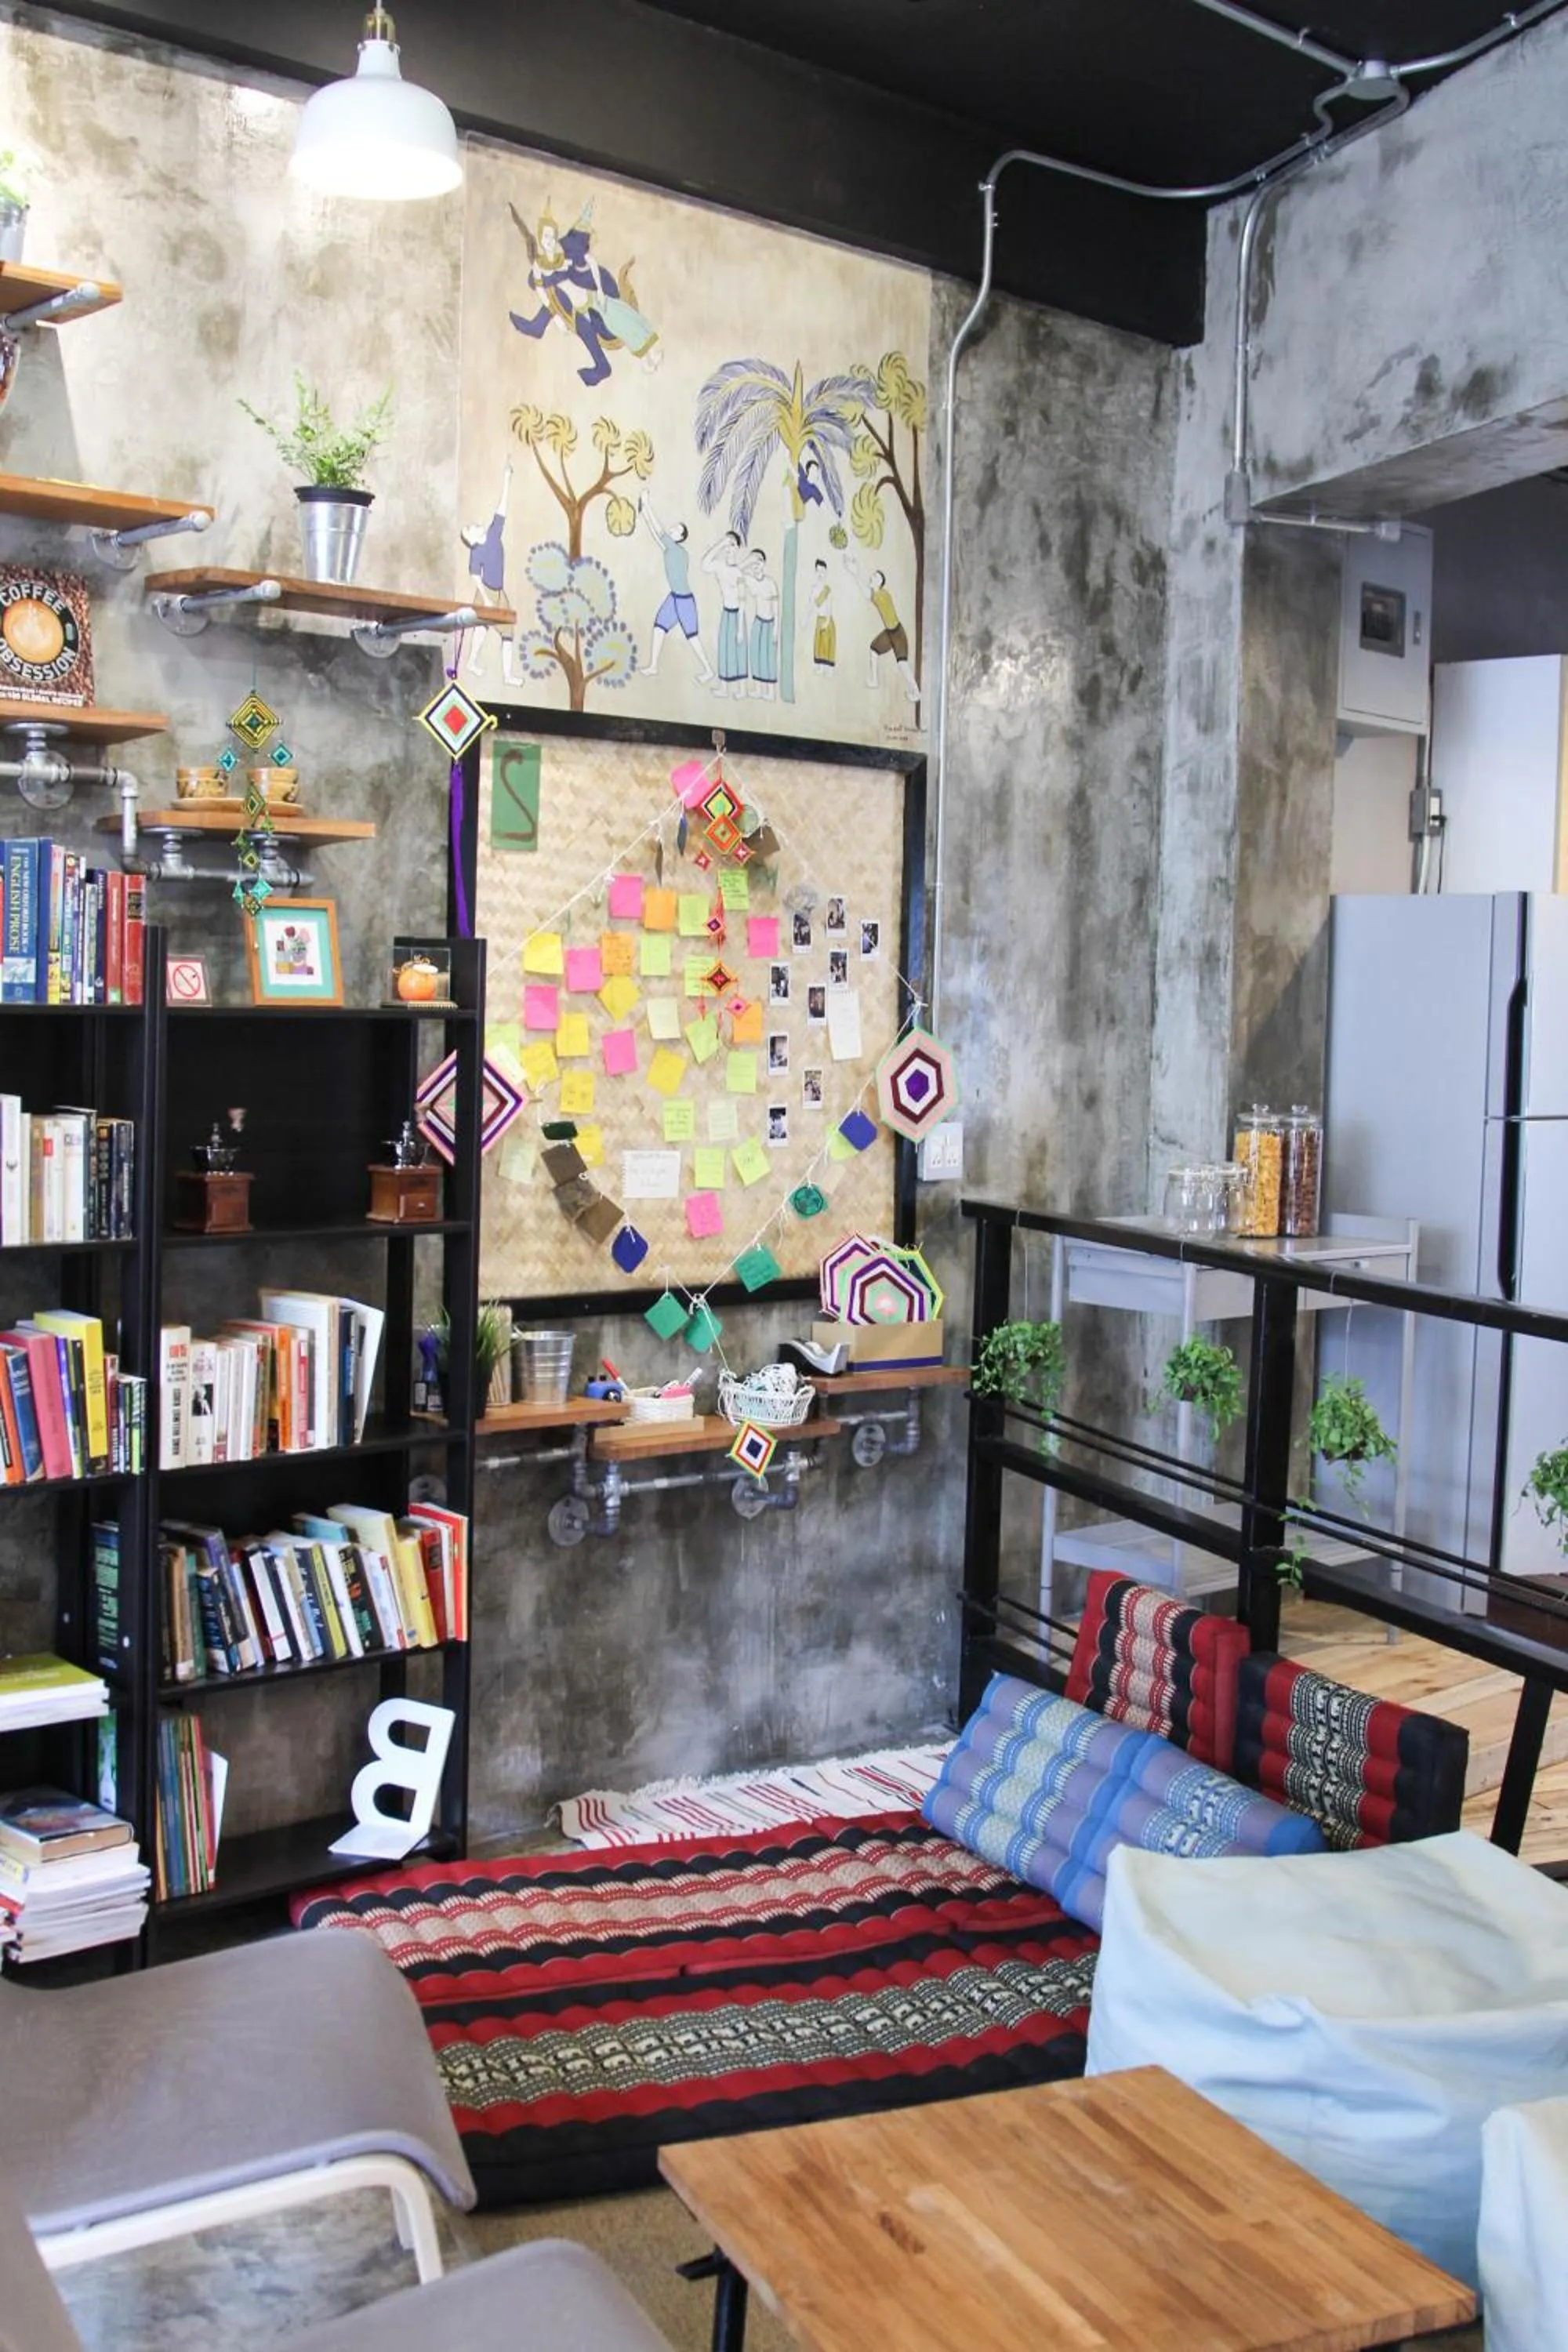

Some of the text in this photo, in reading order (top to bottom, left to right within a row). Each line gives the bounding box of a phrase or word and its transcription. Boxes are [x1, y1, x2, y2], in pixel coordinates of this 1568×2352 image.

[0, 583, 67, 615] COFFEE
[0, 637, 76, 681] OBSESSION
[9, 855, 21, 912] ENGLISH
[9, 913, 20, 953] PROSE
